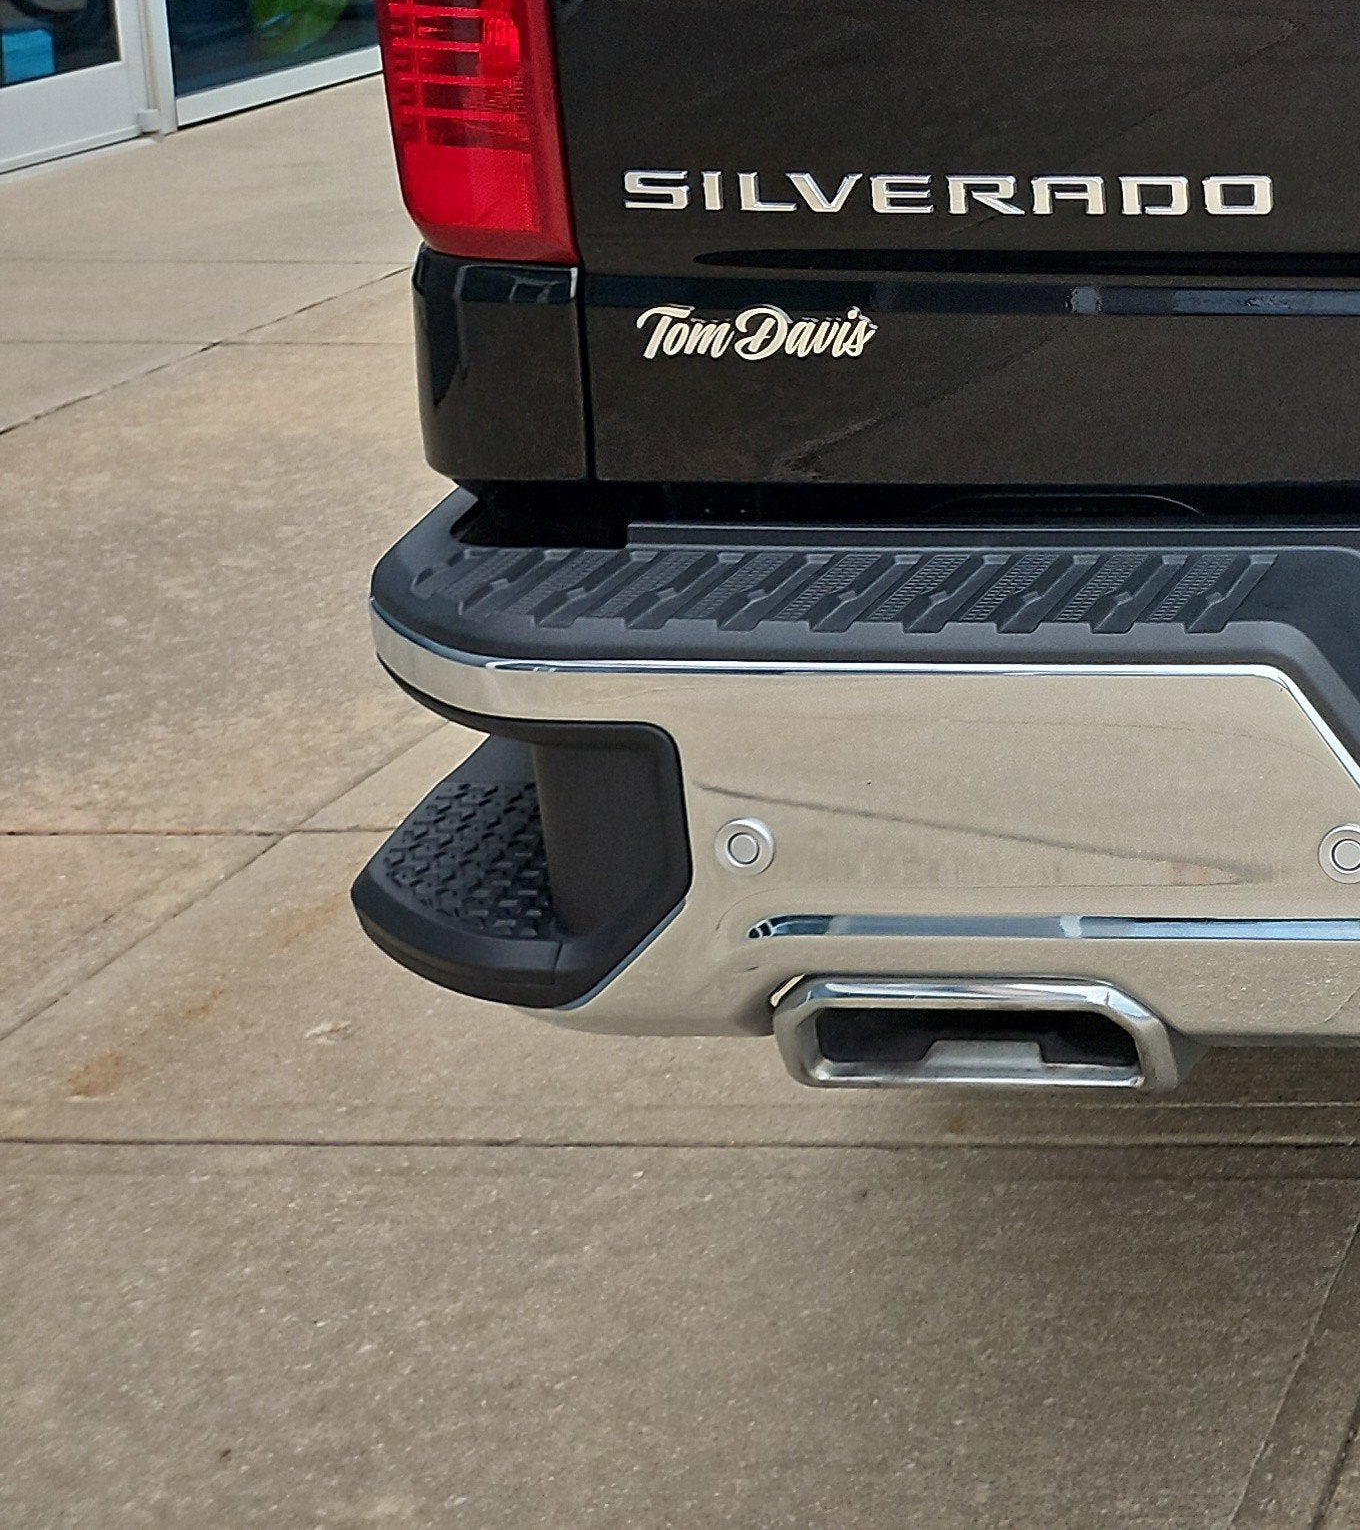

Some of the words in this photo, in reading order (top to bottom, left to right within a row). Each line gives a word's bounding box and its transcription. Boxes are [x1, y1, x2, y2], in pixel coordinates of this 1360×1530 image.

[622, 169, 1275, 216] SILVERADO
[636, 304, 733, 361] Tom
[733, 304, 879, 361] Davis
